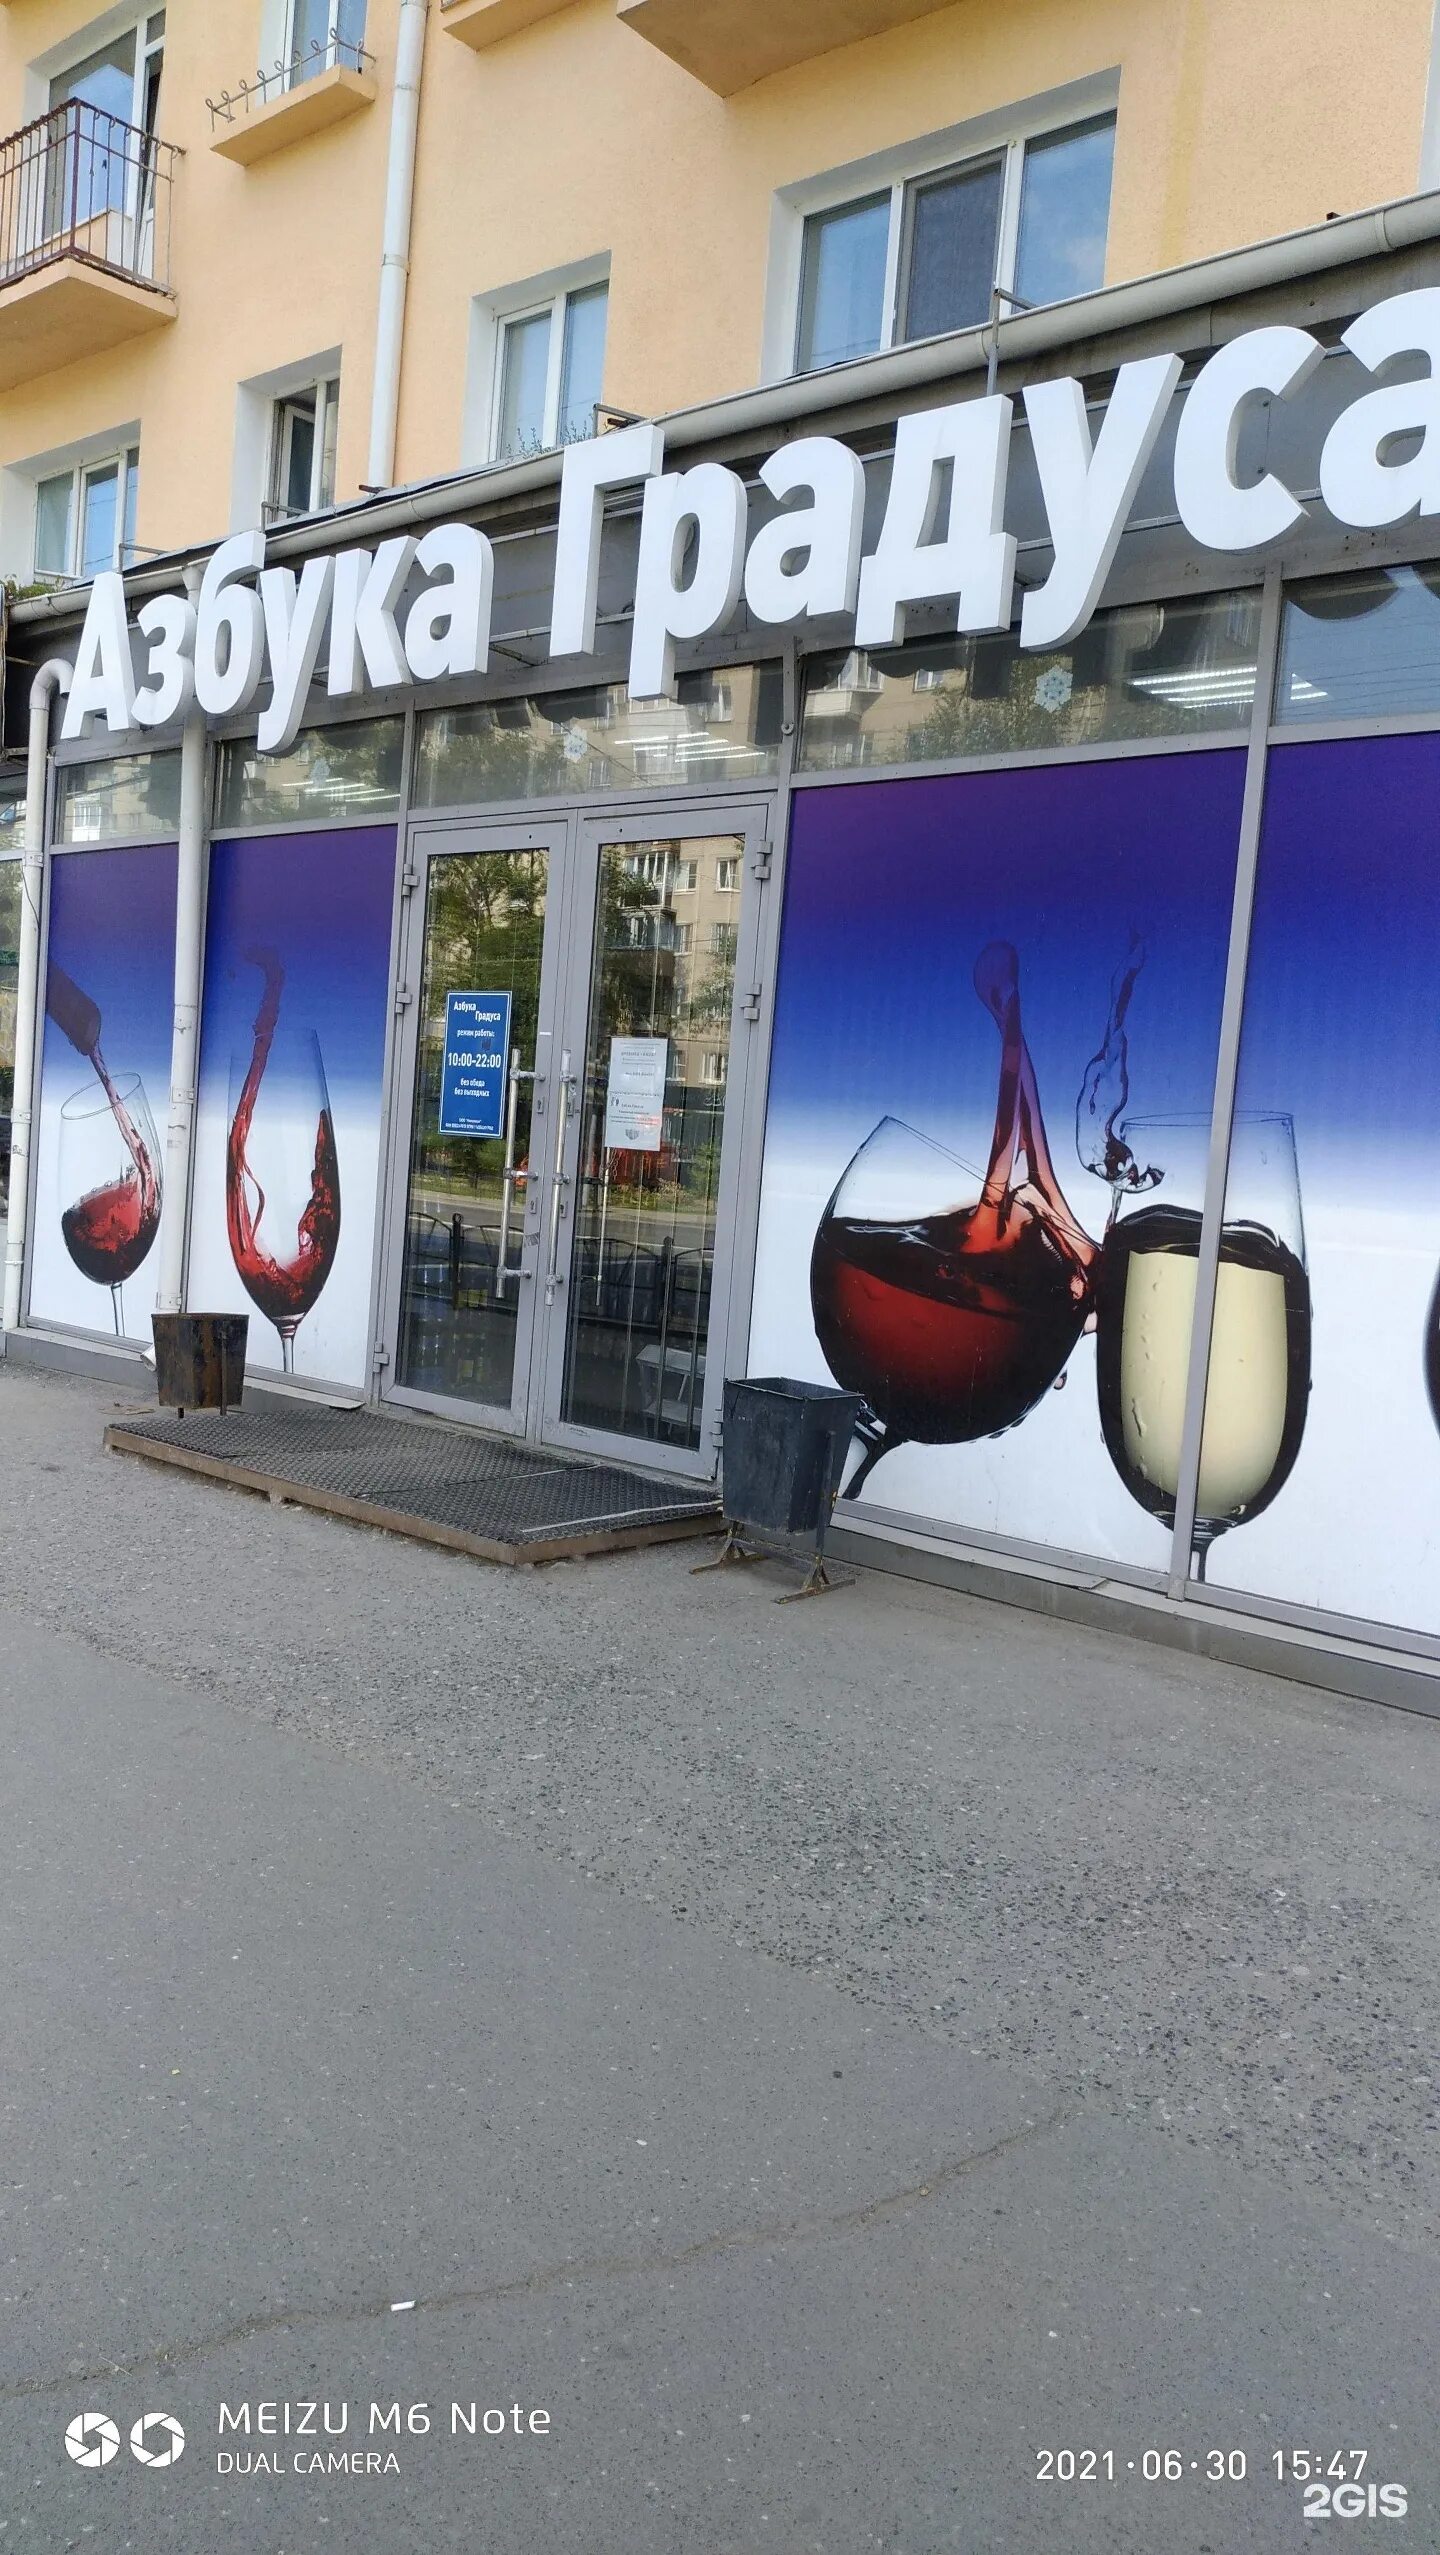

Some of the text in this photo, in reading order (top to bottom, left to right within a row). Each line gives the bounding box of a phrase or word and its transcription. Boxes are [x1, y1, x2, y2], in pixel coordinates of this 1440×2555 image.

[60, 287, 1440, 756] Азбука Градуса
[453, 1001, 477, 1013] Азбука
[475, 1010, 501, 1022] Градуса
[456, 1028, 495, 1038] режим работы:
[447, 1052, 502, 1068] 10:00-22:00
[460, 1078, 486, 1087] без обеда
[454, 1087, 490, 1098] без выходных
